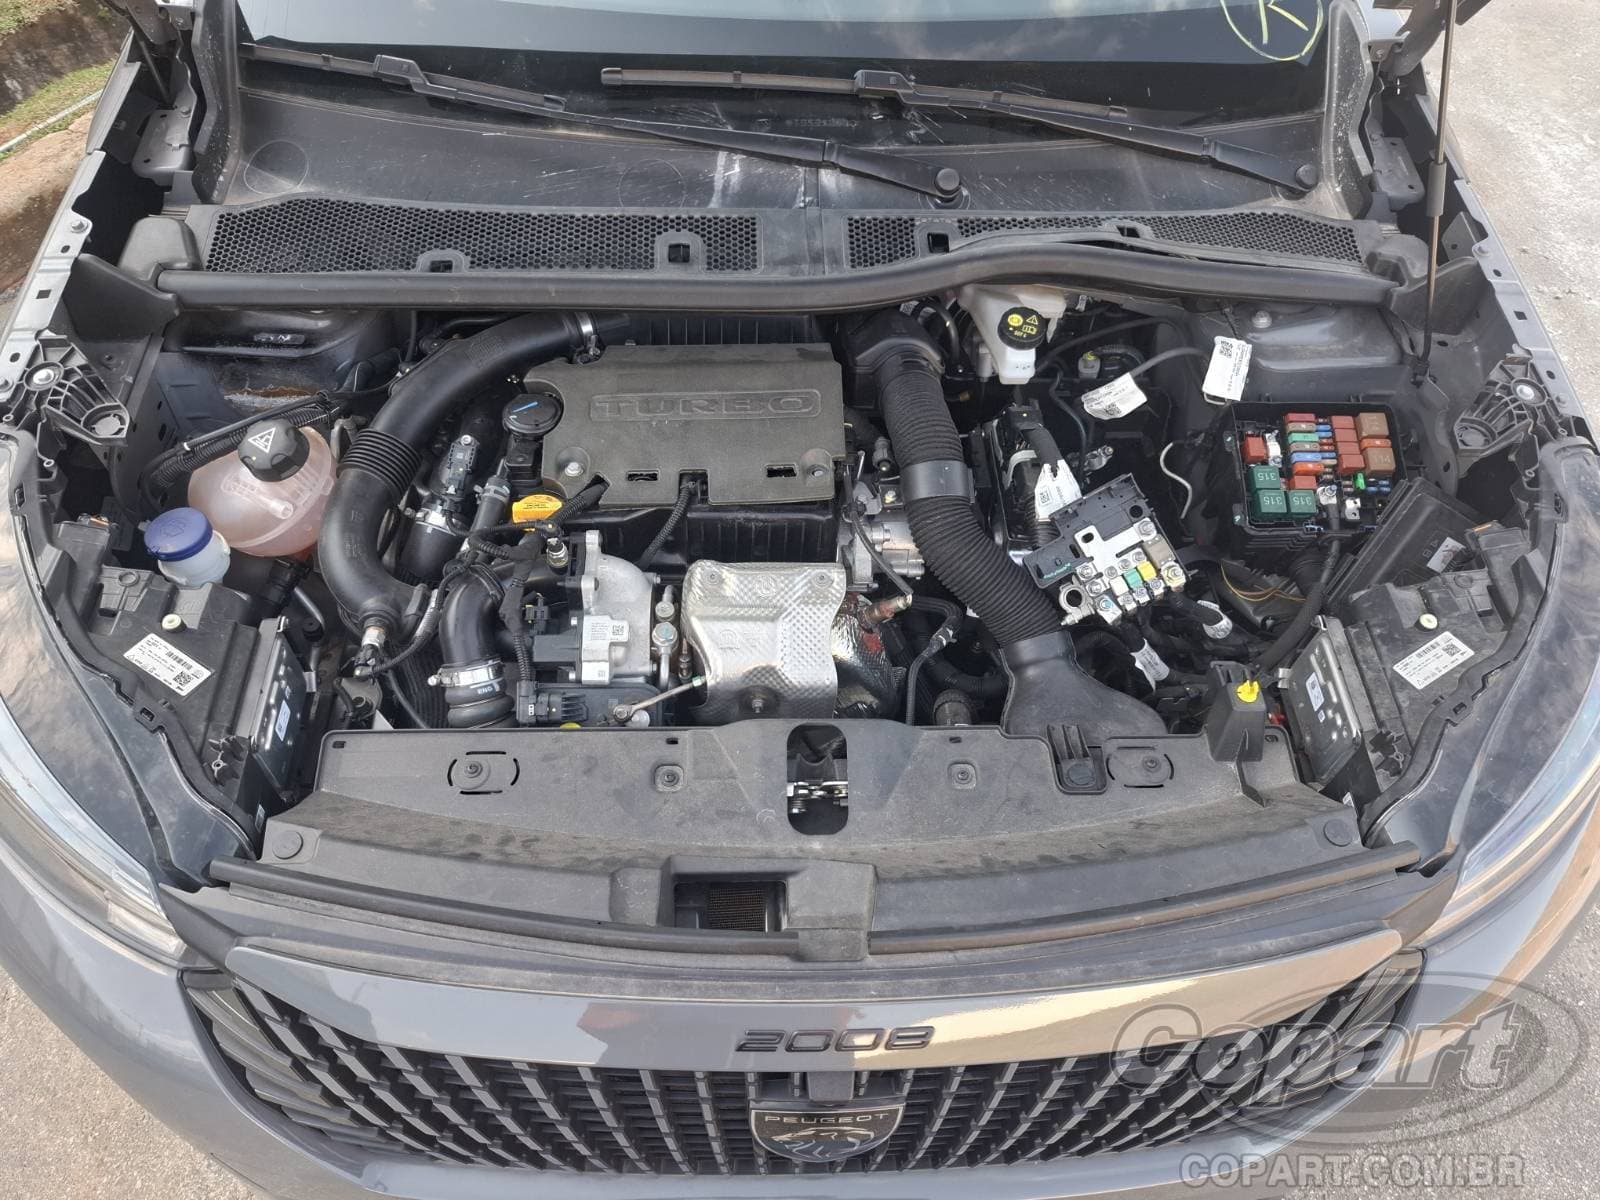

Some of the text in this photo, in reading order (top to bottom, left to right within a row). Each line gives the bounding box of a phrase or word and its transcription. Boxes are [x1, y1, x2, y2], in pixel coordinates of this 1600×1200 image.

[594, 396, 815, 417] TURBO
[1257, 472, 1277, 481] 315
[1263, 496, 1283, 505] 315
[1292, 496, 1312, 505] 315
[735, 1026, 935, 1052] 2008
[764, 1112, 889, 1124] PEUGEOT
